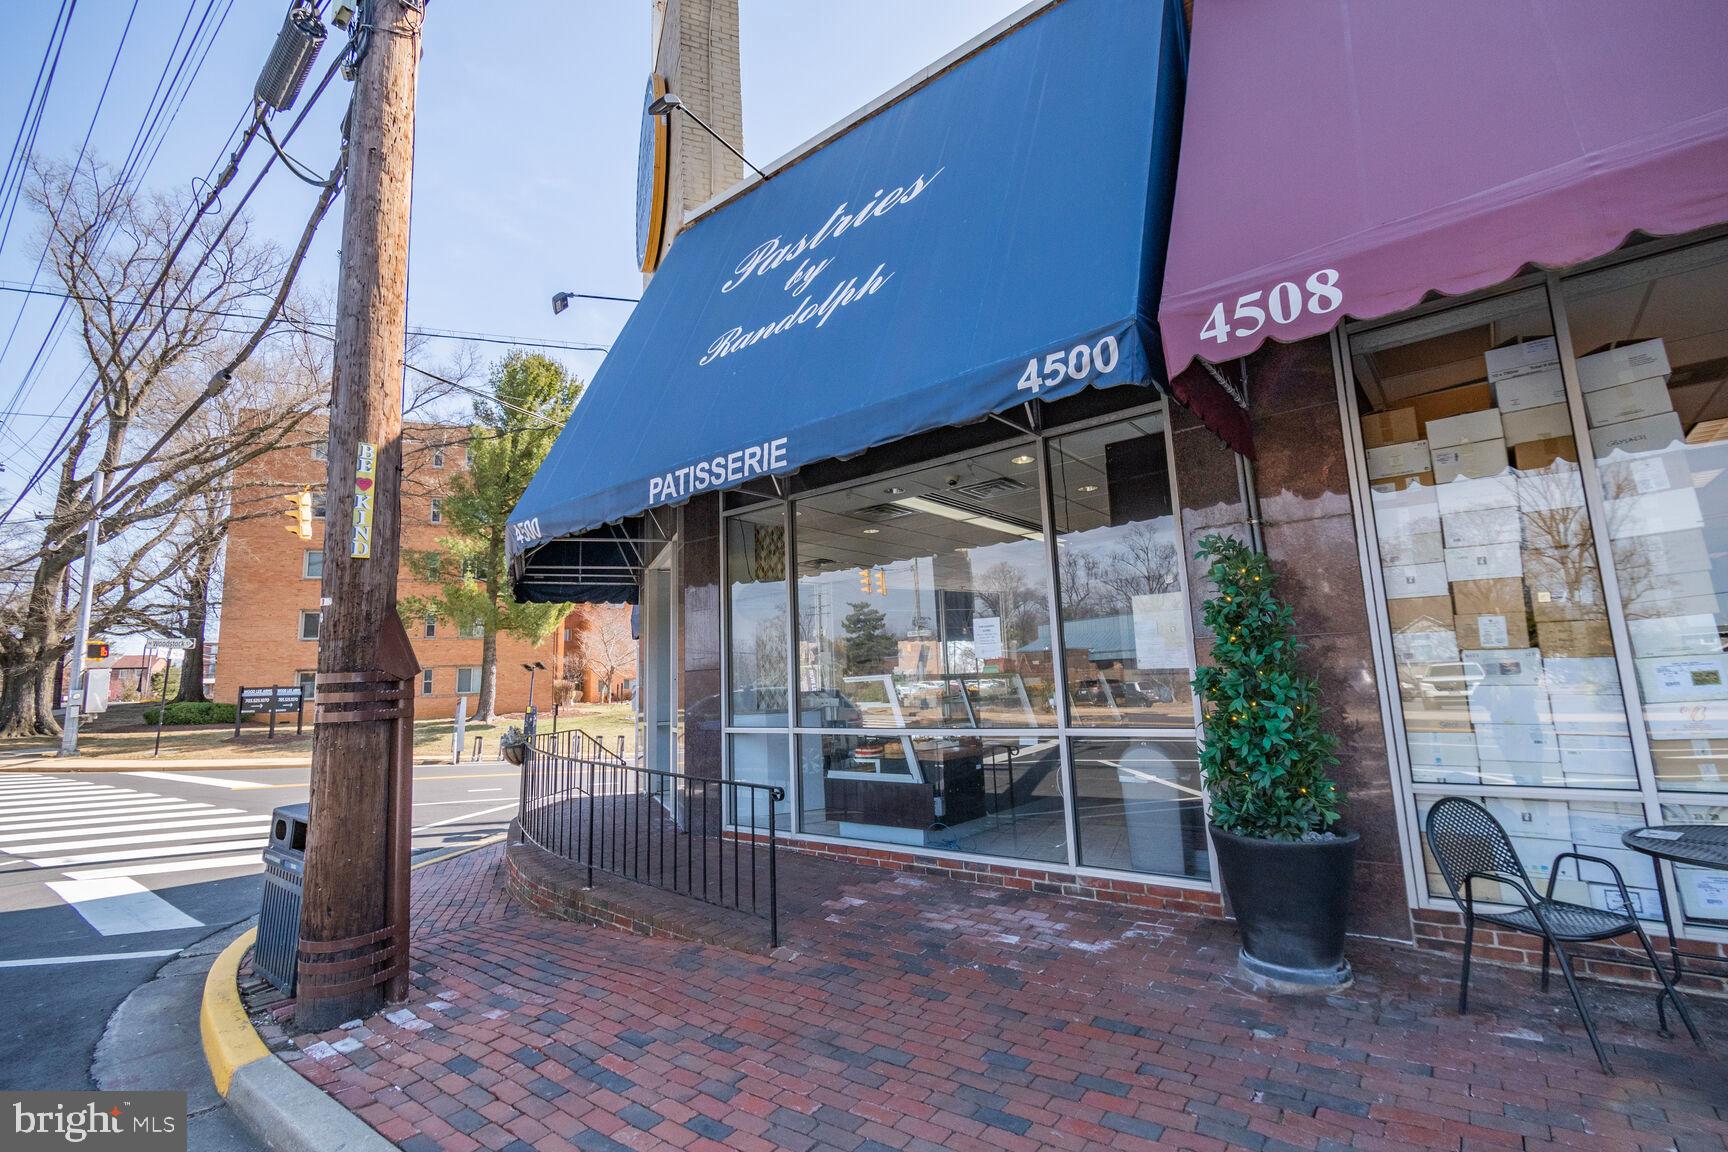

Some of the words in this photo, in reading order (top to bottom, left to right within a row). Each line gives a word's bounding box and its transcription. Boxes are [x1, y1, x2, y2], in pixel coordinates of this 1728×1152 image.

[721, 166, 946, 294] Pastries
[783, 256, 836, 297] by
[1199, 268, 1344, 344] 4508
[699, 262, 896, 366] Randolph
[1016, 335, 1120, 394] 4500
[357, 444, 375, 473] BE
[648, 436, 788, 505] PATISSERIE
[352, 493, 372, 557] KIND
[513, 517, 544, 545] 4500
[153, 640, 185, 648] Woodstock
